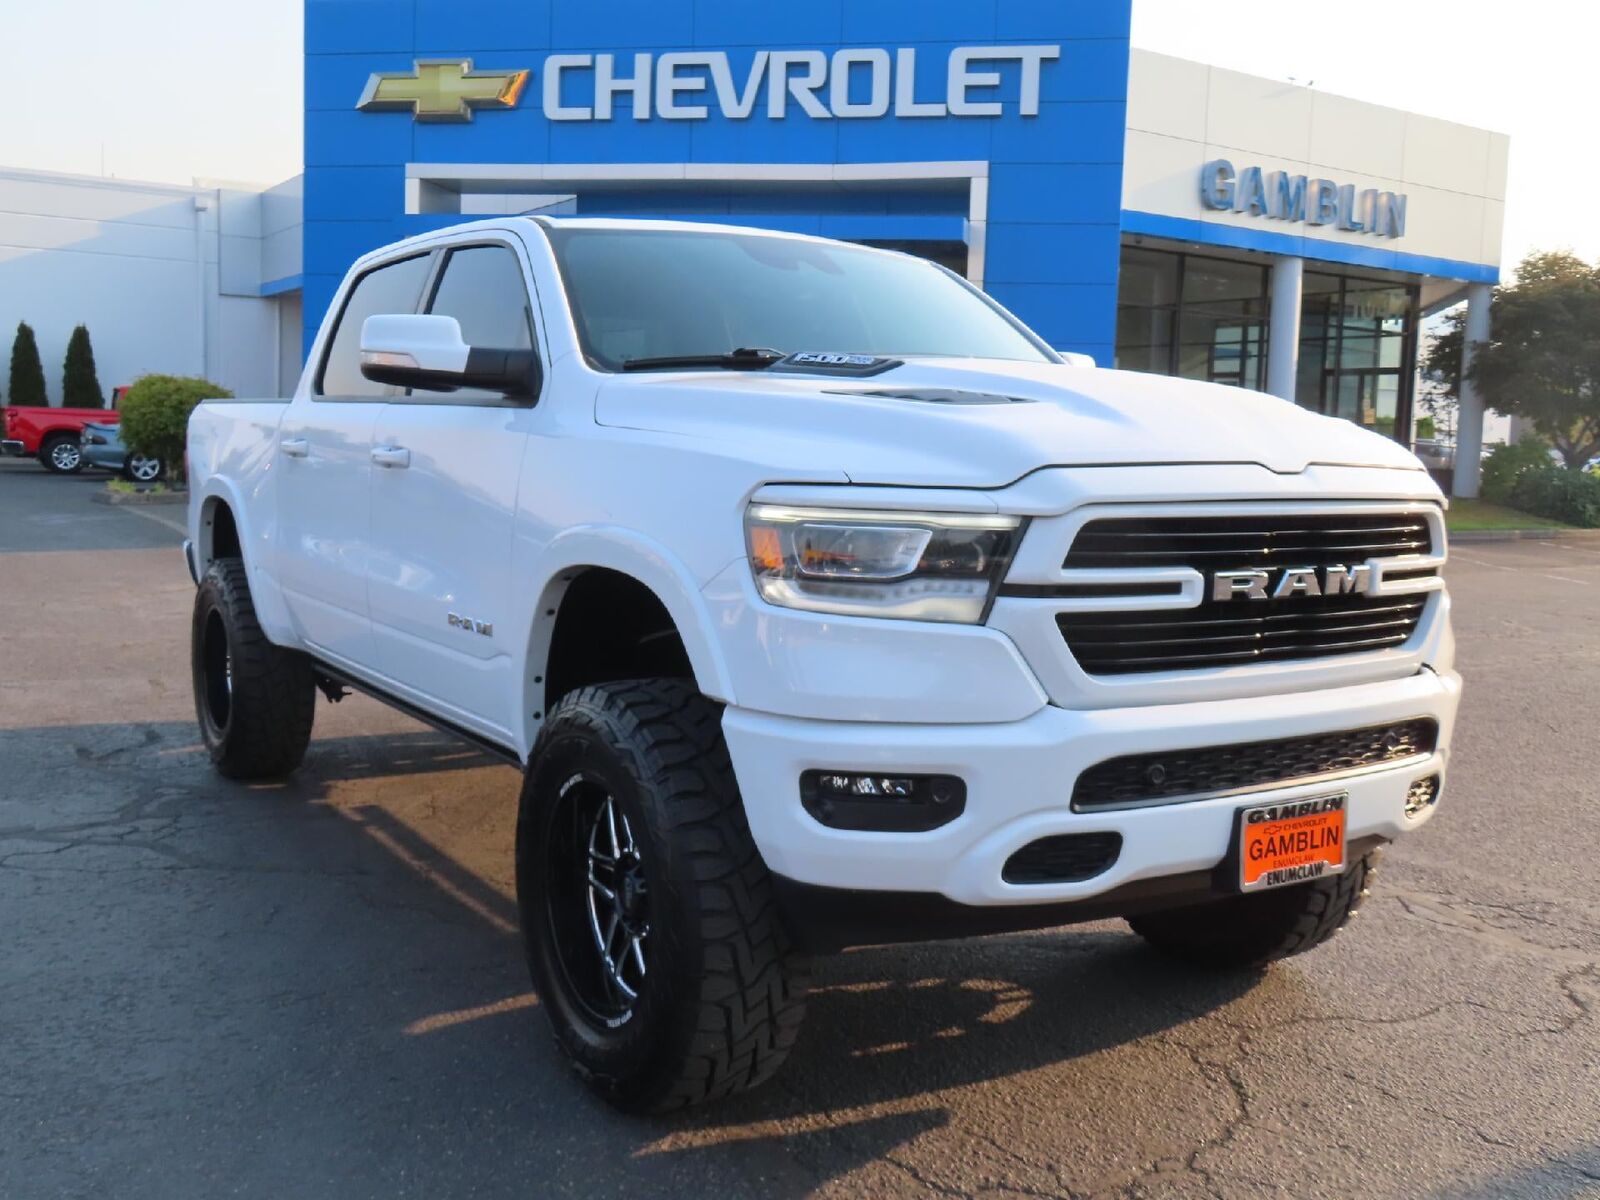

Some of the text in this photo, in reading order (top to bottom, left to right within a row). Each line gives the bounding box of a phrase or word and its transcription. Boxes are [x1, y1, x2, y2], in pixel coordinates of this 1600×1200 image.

[543, 45, 1060, 120] CHEVROLET
[1201, 159, 1407, 239] GAMBLIN
[1213, 564, 1371, 601] RAM
[447, 611, 493, 637] RAM
[1247, 796, 1344, 824] GAMBLIN
[1283, 817, 1328, 831] CHEVROLET
[1249, 825, 1340, 861] GAMBLIN
[1266, 861, 1325, 886] ENUMCLAW
